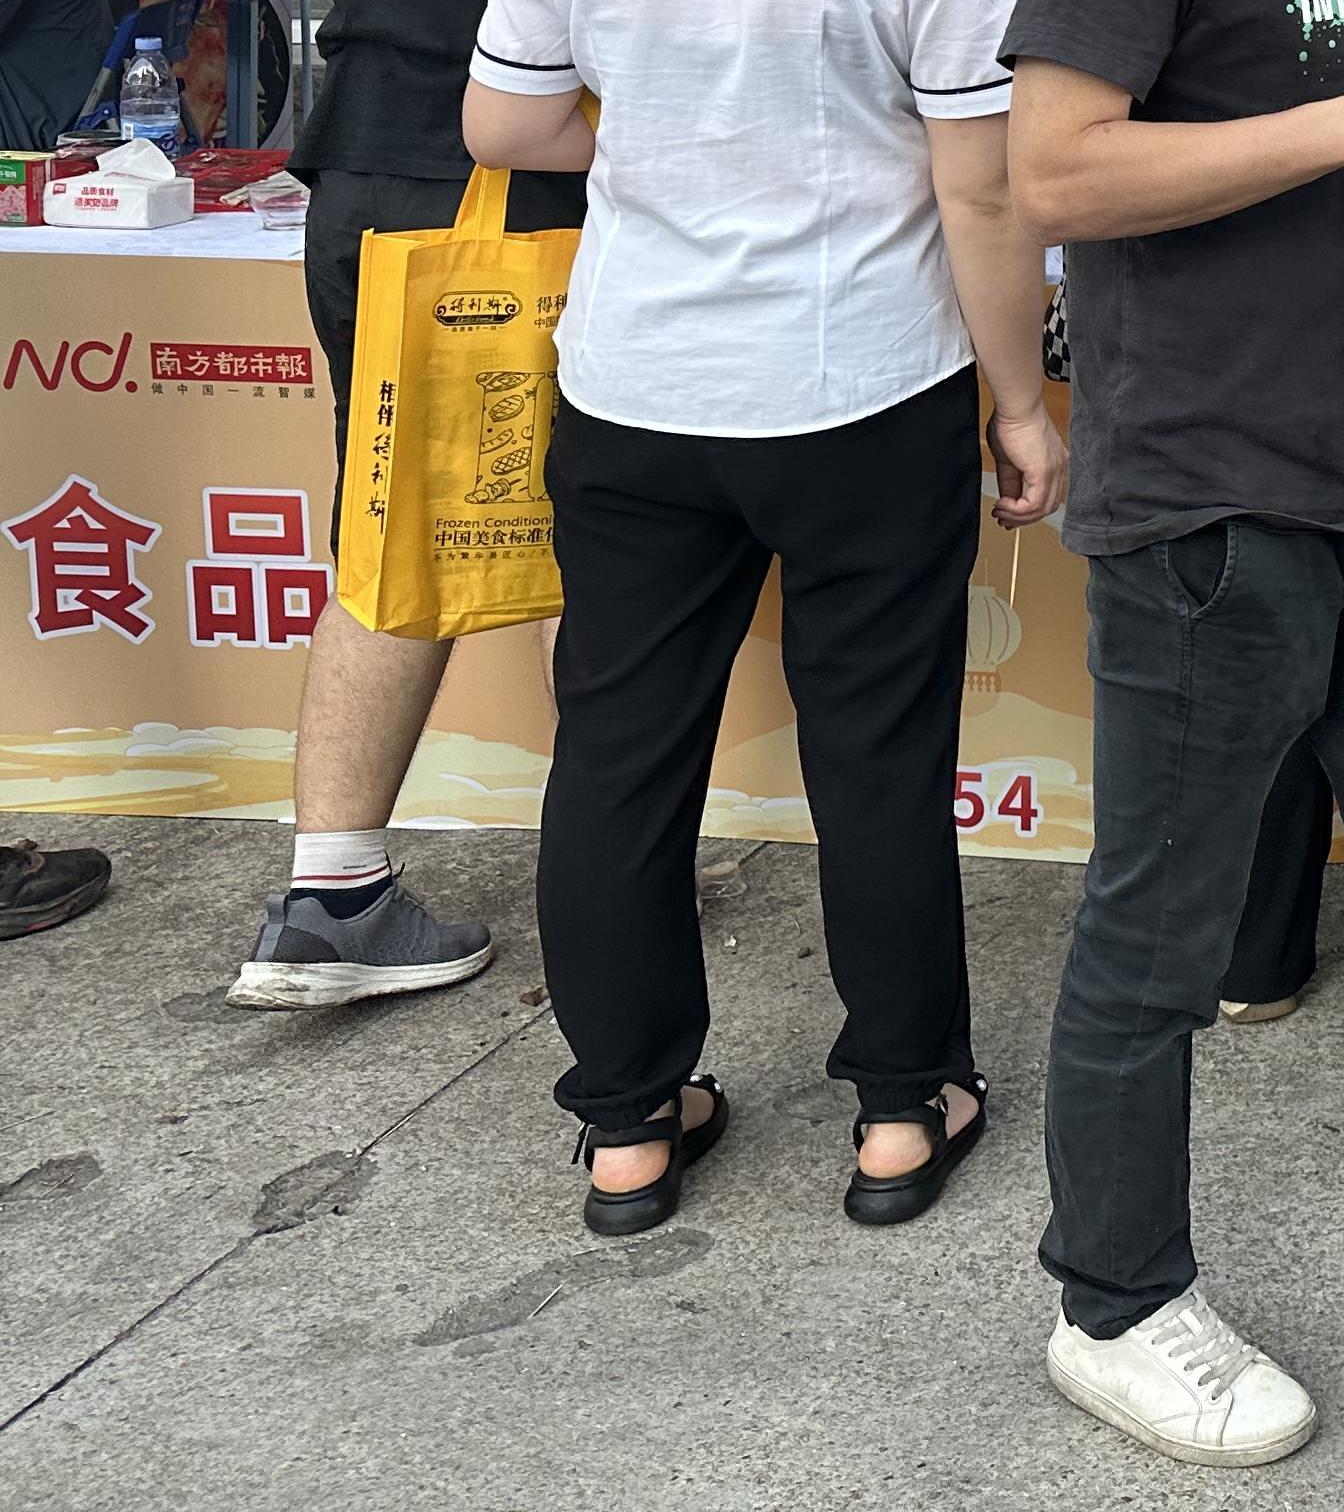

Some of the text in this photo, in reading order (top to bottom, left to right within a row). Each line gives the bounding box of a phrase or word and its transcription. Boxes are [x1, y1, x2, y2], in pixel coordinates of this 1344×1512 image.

[150, 381, 317, 401] 做中国一流智媒
[435, 517, 480, 529] Frozen
[2, 474, 333, 648] 食品
